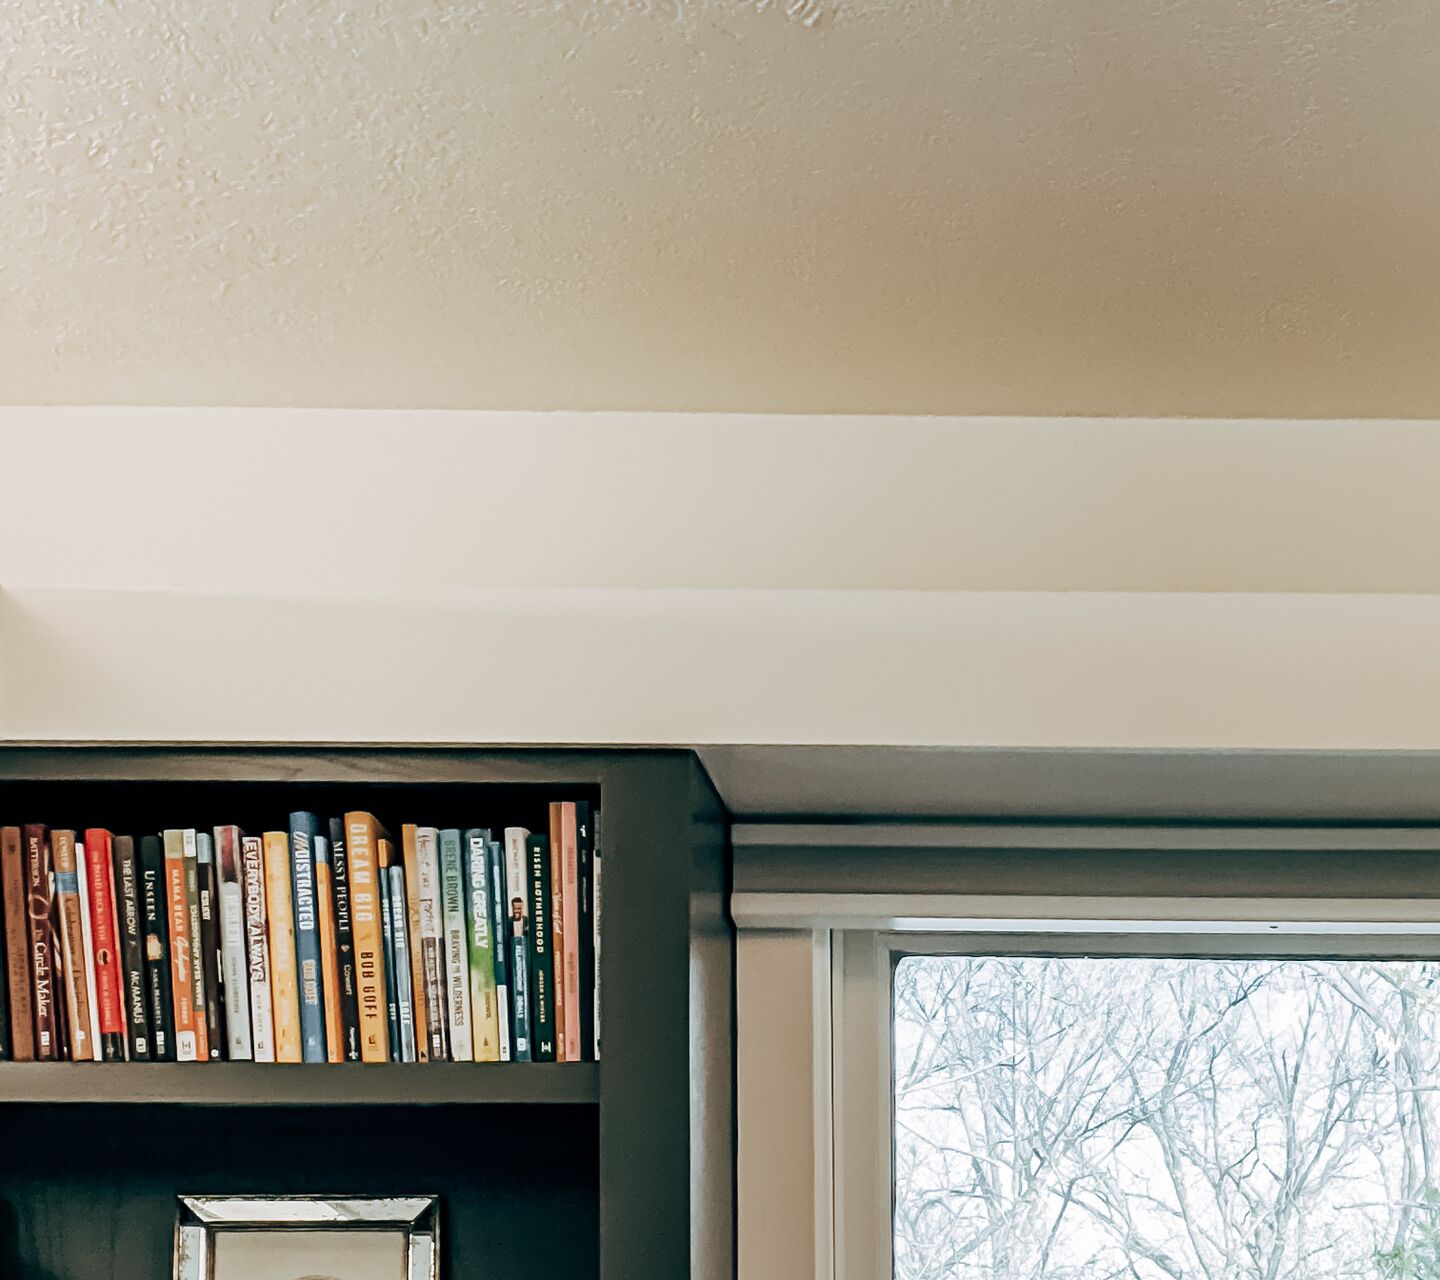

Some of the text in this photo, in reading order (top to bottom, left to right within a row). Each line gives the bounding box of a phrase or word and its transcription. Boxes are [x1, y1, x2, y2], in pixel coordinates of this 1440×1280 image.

[123, 877, 134, 897] LAST
[171, 869, 182, 900] MAMA
[293, 831, 315, 931] UNDISTRACTED
[333, 841, 350, 933] MESSY PEOPLE
[350, 823, 375, 923] DREAM BIG
[446, 875, 460, 912] BROWN
[469, 837, 489, 949] DARING GREATLY
[533, 846, 545, 954] RISEN MOTHERHOOD
[125, 900, 137, 936] ARROW
[173, 904, 184, 933] BEAR
[245, 841, 267, 983] EVERYBODY ALWAYS
[34, 942, 51, 1019] Circle Maker
[130, 971, 145, 1024] McMANUS
[360, 952, 378, 1019] BOB GOFF
[448, 929, 464, 1027] BRAVING WILDERNESS
